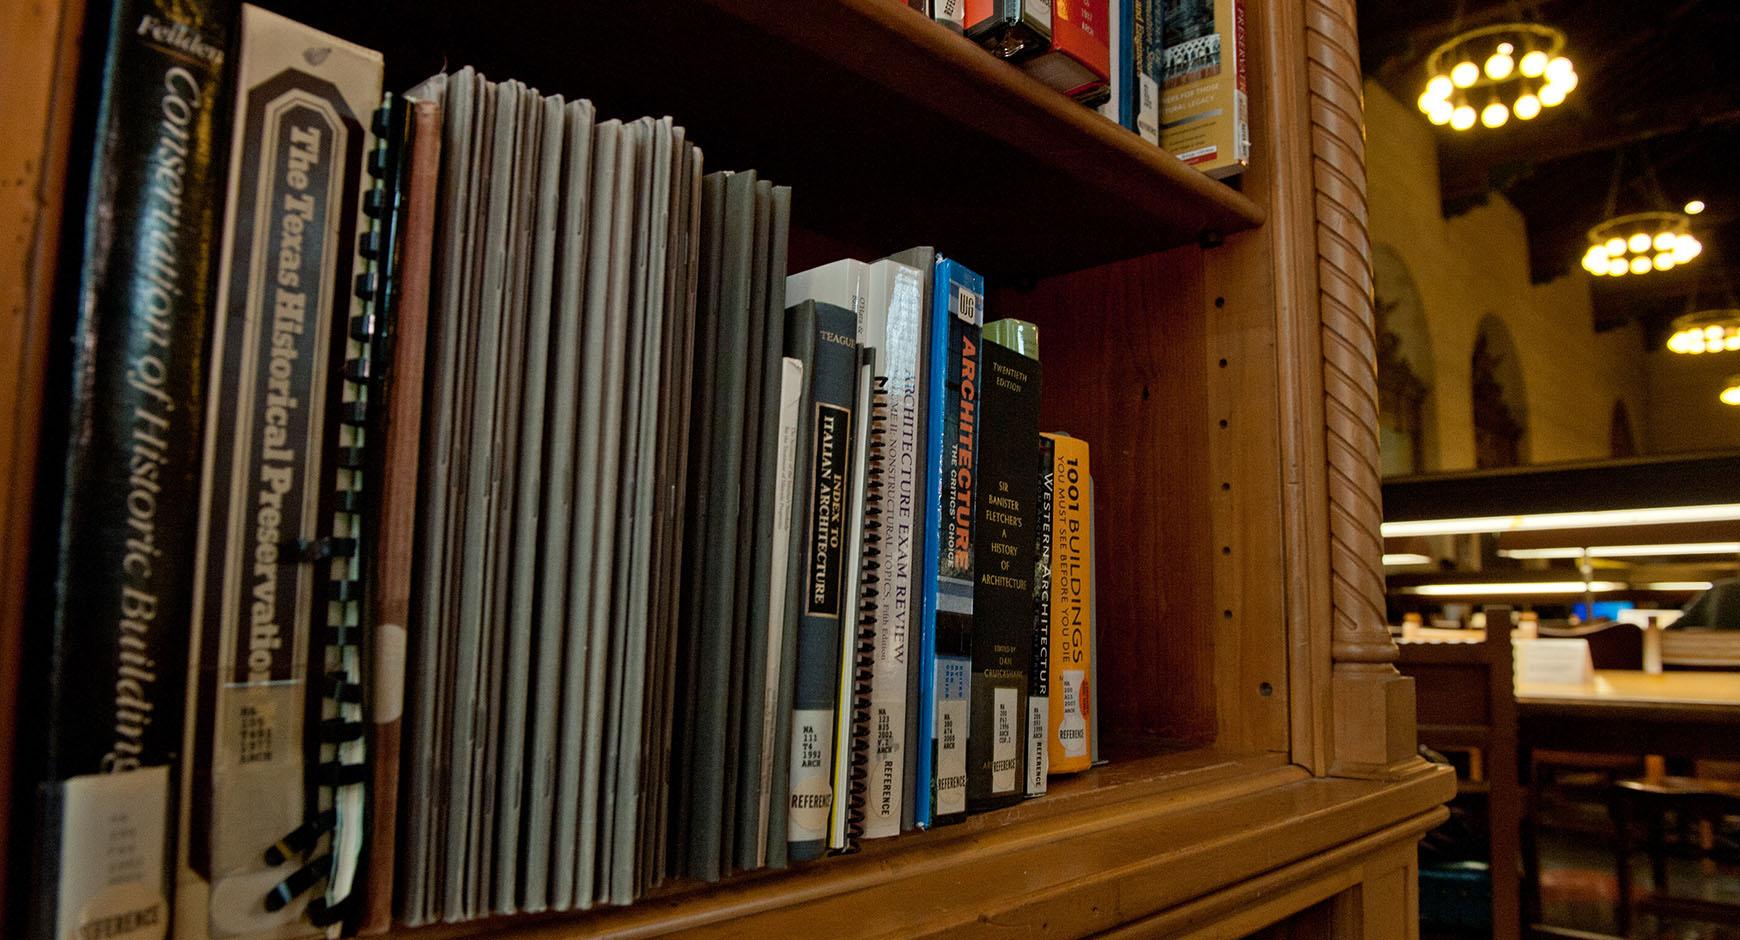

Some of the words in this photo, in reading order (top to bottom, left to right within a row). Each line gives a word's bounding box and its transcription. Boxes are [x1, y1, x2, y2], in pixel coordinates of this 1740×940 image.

[286, 125, 321, 190] The
[143, 67, 201, 348] Conservation
[277, 193, 315, 288] Texas
[820, 331, 856, 349] TEAGUE
[126, 355, 175, 412] of
[262, 288, 306, 461] Historical
[993, 362, 1027, 383] TWENTIETH
[996, 378, 1021, 393] EDITION
[821, 416, 834, 480] ITALIAN
[899, 369, 915, 518] ARCHITECTURE
[955, 335, 976, 571] ARCHITECTURE
[1057, 455, 1065, 483] YOU
[1067, 458, 1079, 511] 1001
[122, 408, 171, 578] Historic
[831, 475, 842, 523] INDEX
[885, 440, 897, 549] NONSTRUCTURAL
[999, 481, 1009, 492] SIR
[988, 495, 1019, 511] BANISTER
[1042, 473, 1053, 557] WESTERN
[1058, 488, 1067, 525] MUST
[986, 510, 1023, 528] FLETCHER'S
[1002, 529, 1007, 538] A
[815, 482, 831, 605] ARCHITECTURE
[830, 524, 840, 548] TO
[896, 524, 909, 578] EXAM
[947, 523, 956, 568] CHOICE
[991, 542, 1018, 556] HISTORY
[1059, 529, 1067, 549] SEE
[1000, 560, 1010, 571] OF
[1060, 555, 1068, 603] BEFORE
[981, 574, 1027, 591] ARCHITECTURE
[1068, 519, 1083, 664] BUILDINGS
[881, 604, 890, 626] Fifth
[894, 586, 907, 664] REVIEW
[1061, 608, 1069, 637] YOU
[880, 627, 889, 661] Edition
[1062, 642, 1070, 663] DIE
[999, 656, 1012, 665] DAN
[803, 726, 813, 734] NA
[801, 760, 821, 768] ARCH
[803, 751, 821, 759] 1992
[993, 759, 1015, 773] REFERENCE
[881, 761, 893, 816] REFERENCE
[938, 776, 966, 790] REFERENCE
